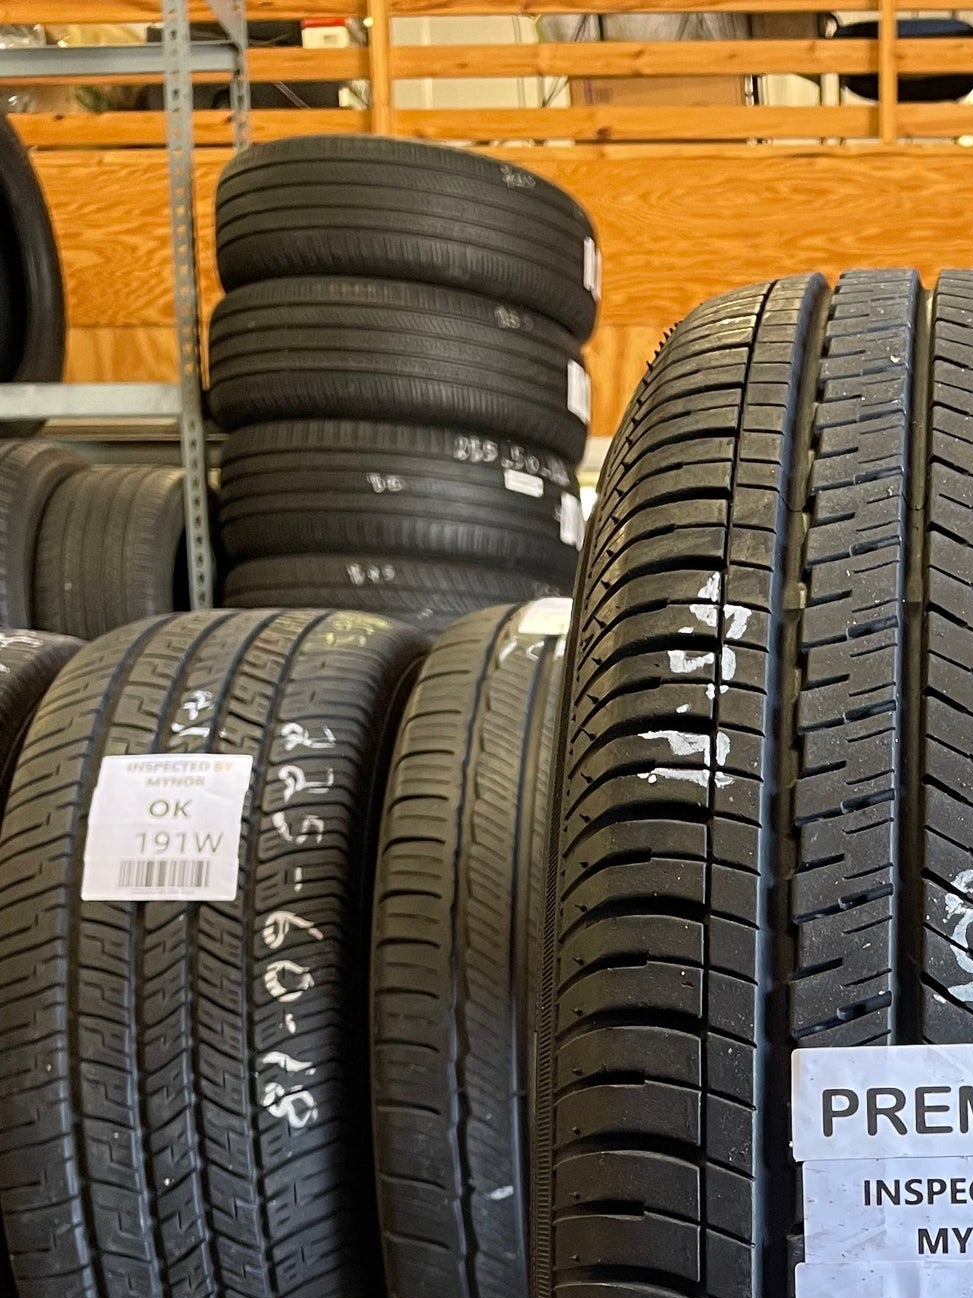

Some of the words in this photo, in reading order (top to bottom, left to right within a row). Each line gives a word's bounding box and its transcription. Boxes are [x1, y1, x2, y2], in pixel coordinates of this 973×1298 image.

[127, 760, 211, 774] INSPECTED
[149, 799, 193, 818] OK
[137, 830, 225, 854] 191W
